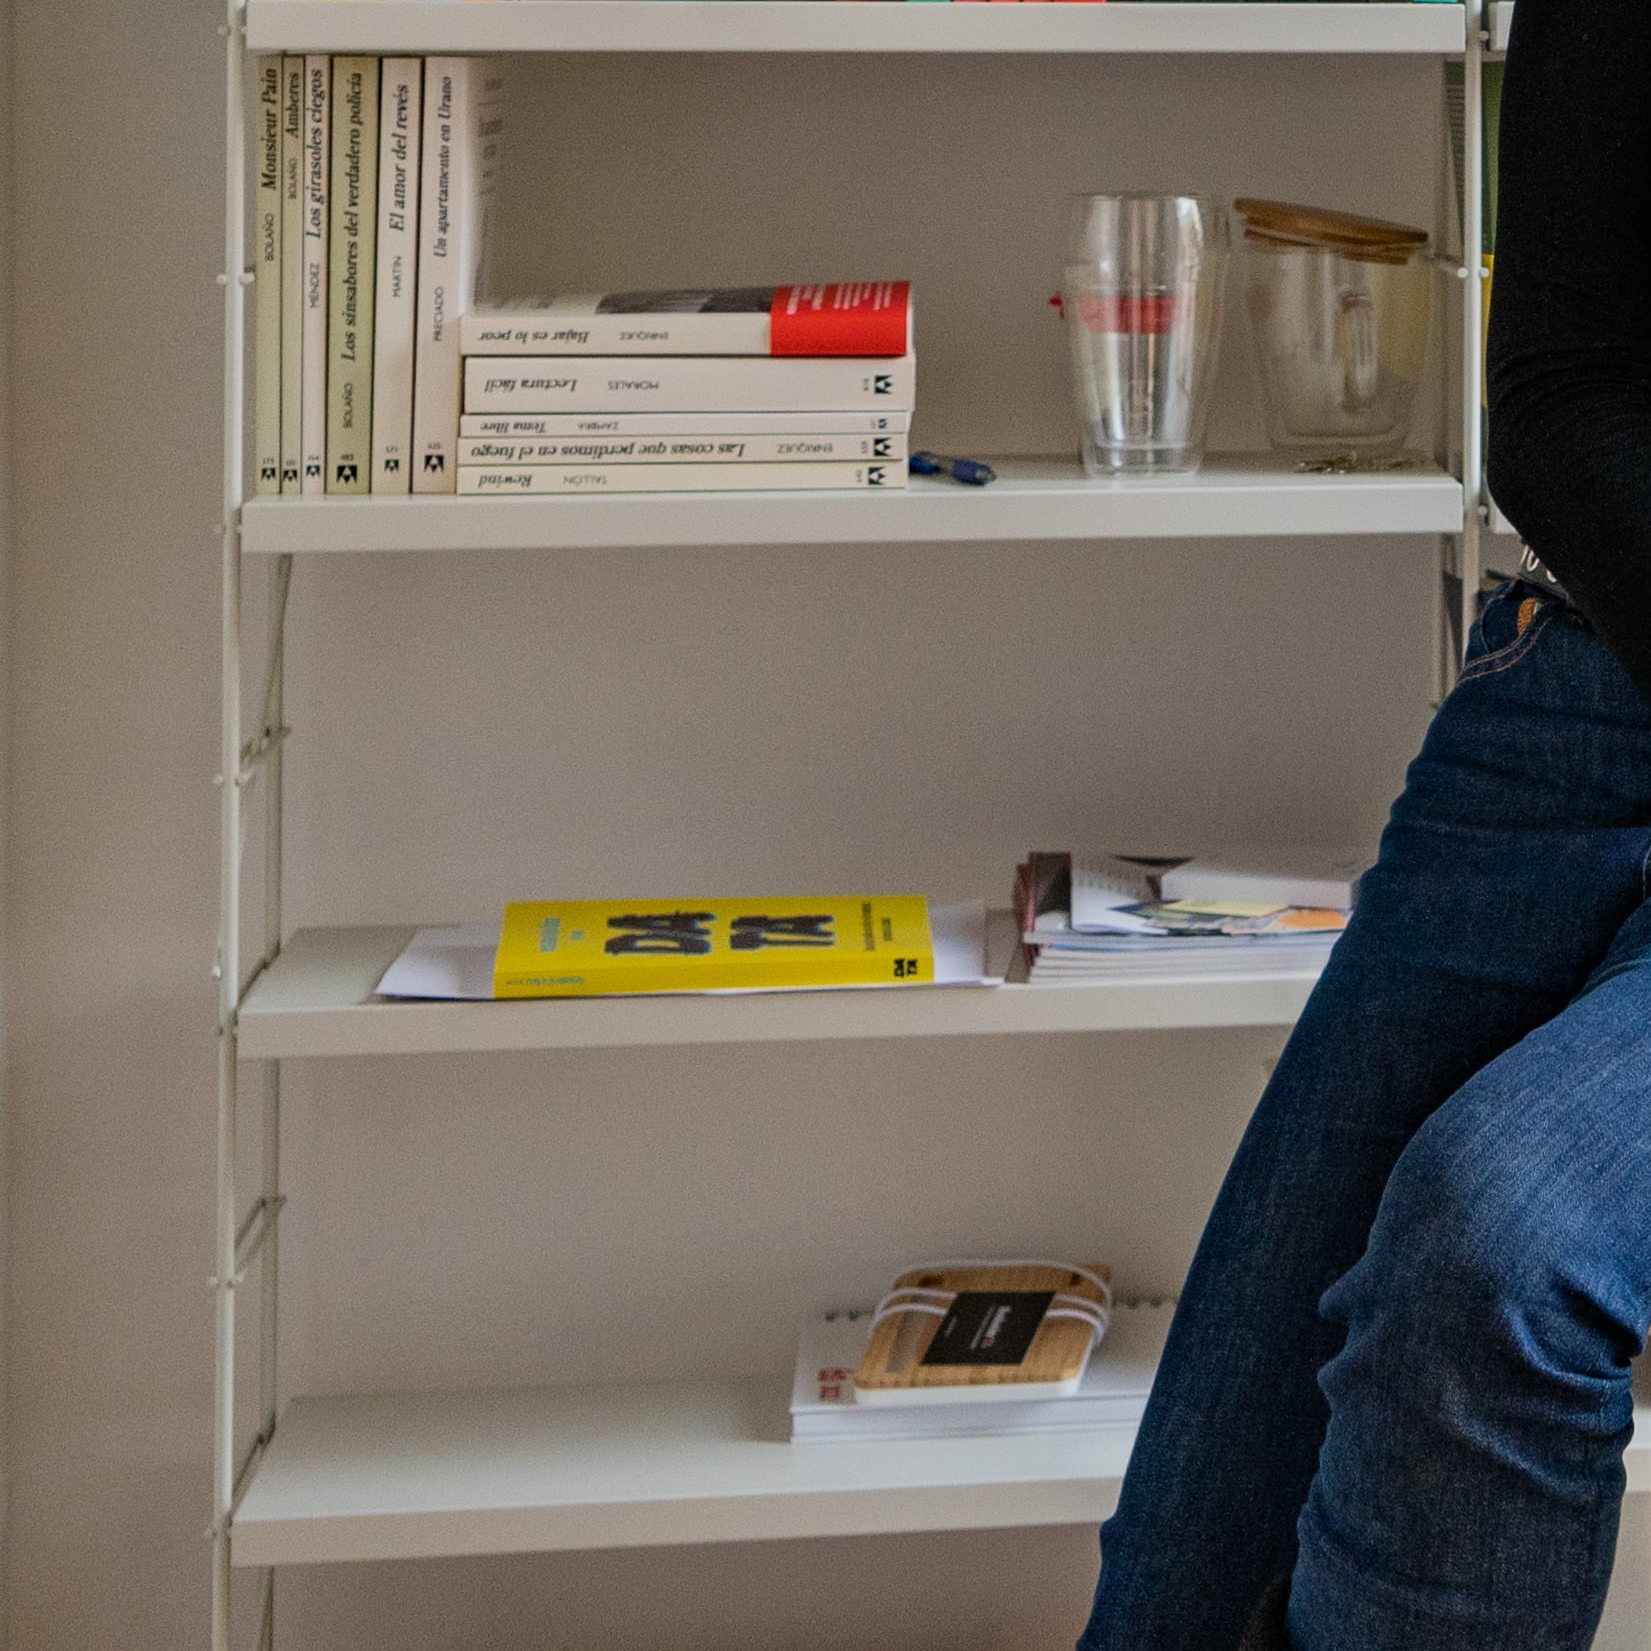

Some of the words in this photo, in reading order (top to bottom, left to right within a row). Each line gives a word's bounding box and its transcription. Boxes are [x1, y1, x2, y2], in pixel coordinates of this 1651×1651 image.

[260, 67, 277, 105] Pain
[260, 108, 278, 191] Monsieur
[263, 211, 275, 262] BOLAÑO
[483, 378, 517, 393] fácil
[519, 378, 578, 392] Lectura
[606, 379, 660, 391] MORALES
